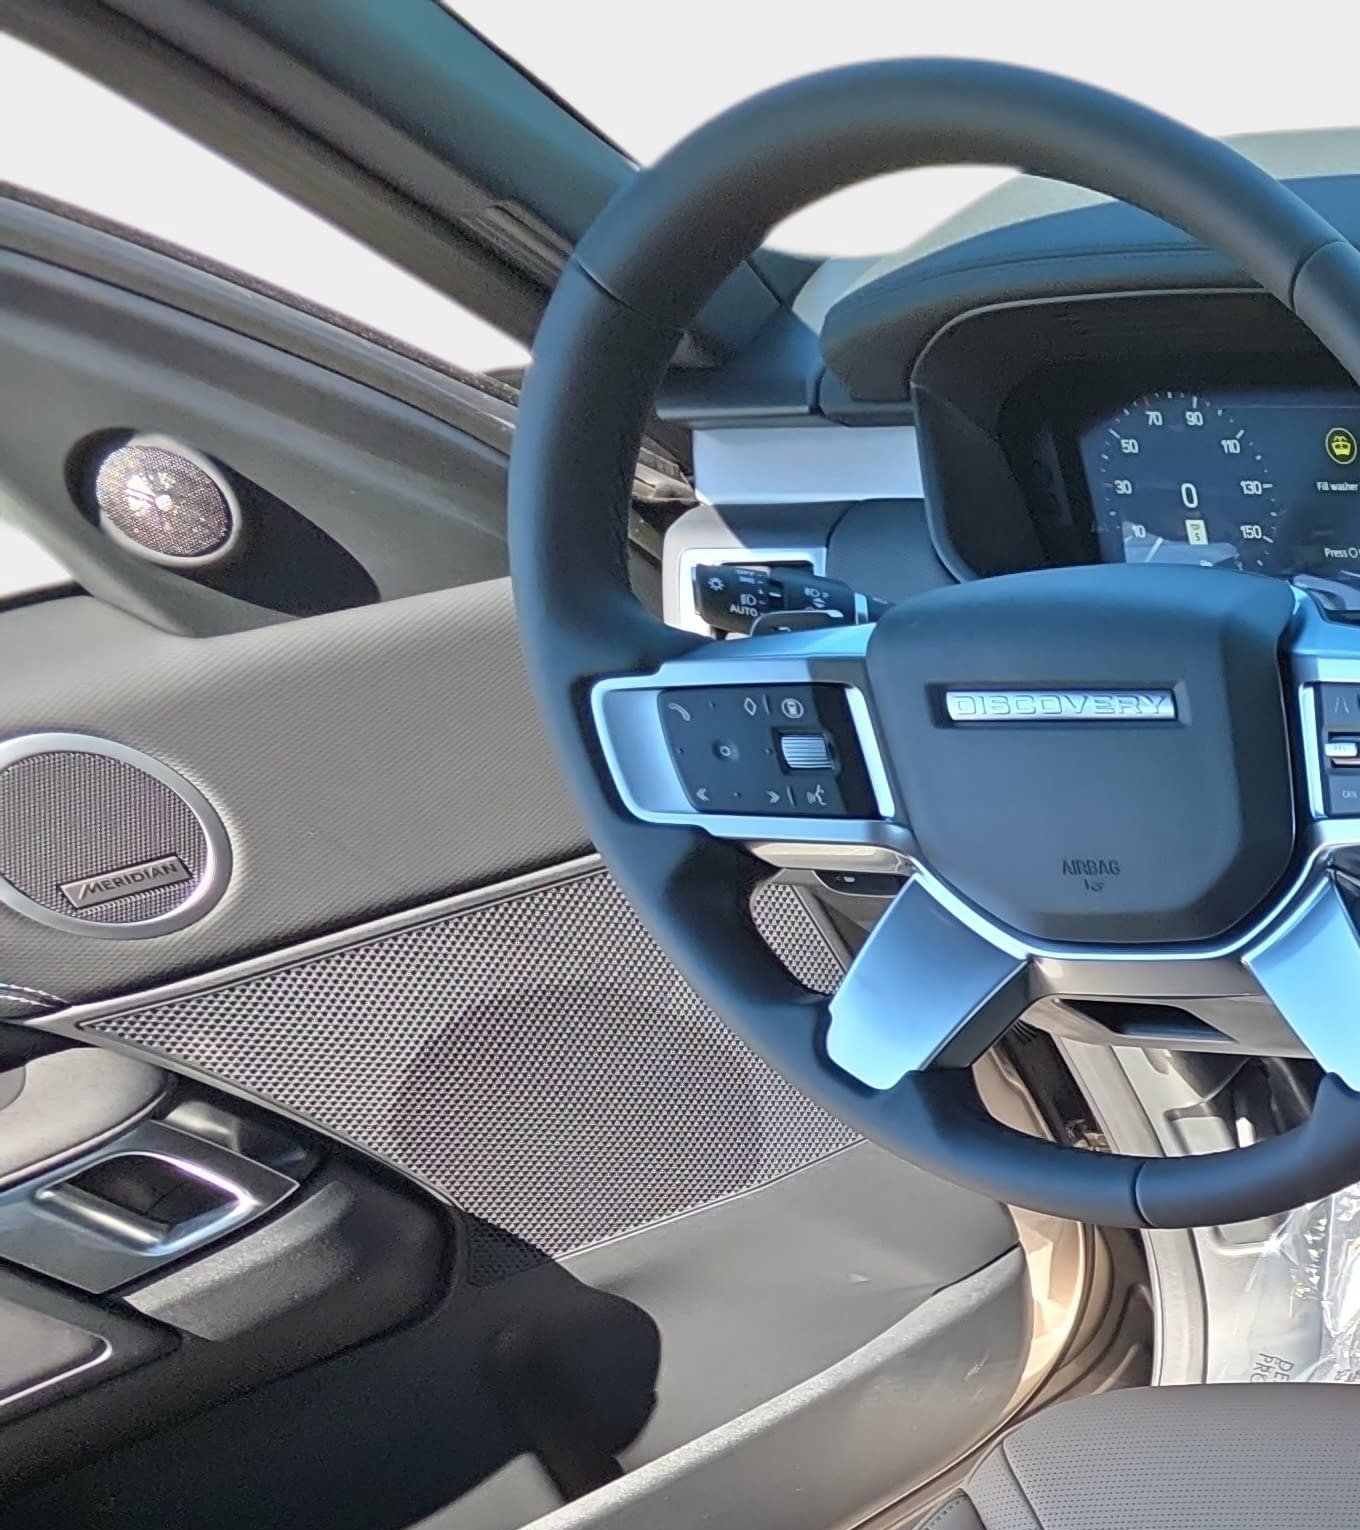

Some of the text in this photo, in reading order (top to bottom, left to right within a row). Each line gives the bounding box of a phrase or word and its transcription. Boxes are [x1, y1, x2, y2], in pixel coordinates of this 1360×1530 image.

[1145, 411, 1163, 426] 70
[1185, 411, 1203, 426] 90
[1120, 439, 1139, 454] 50
[1221, 439, 1241, 454] 110
[1114, 480, 1133, 494] 30
[1240, 480, 1263, 494] 130
[1316, 481, 1329, 491] Fill
[1330, 482, 1358, 491] washer
[1180, 482, 1199, 508] 0
[1132, 525, 1146, 538] 10
[1240, 525, 1263, 539] 150
[1324, 547, 1348, 558] Press
[729, 604, 758, 617] AUTO
[951, 694, 1167, 716] DISCOVERY
[1062, 859, 1121, 876] AIRBAG
[78, 862, 178, 901] MERIDIAN
